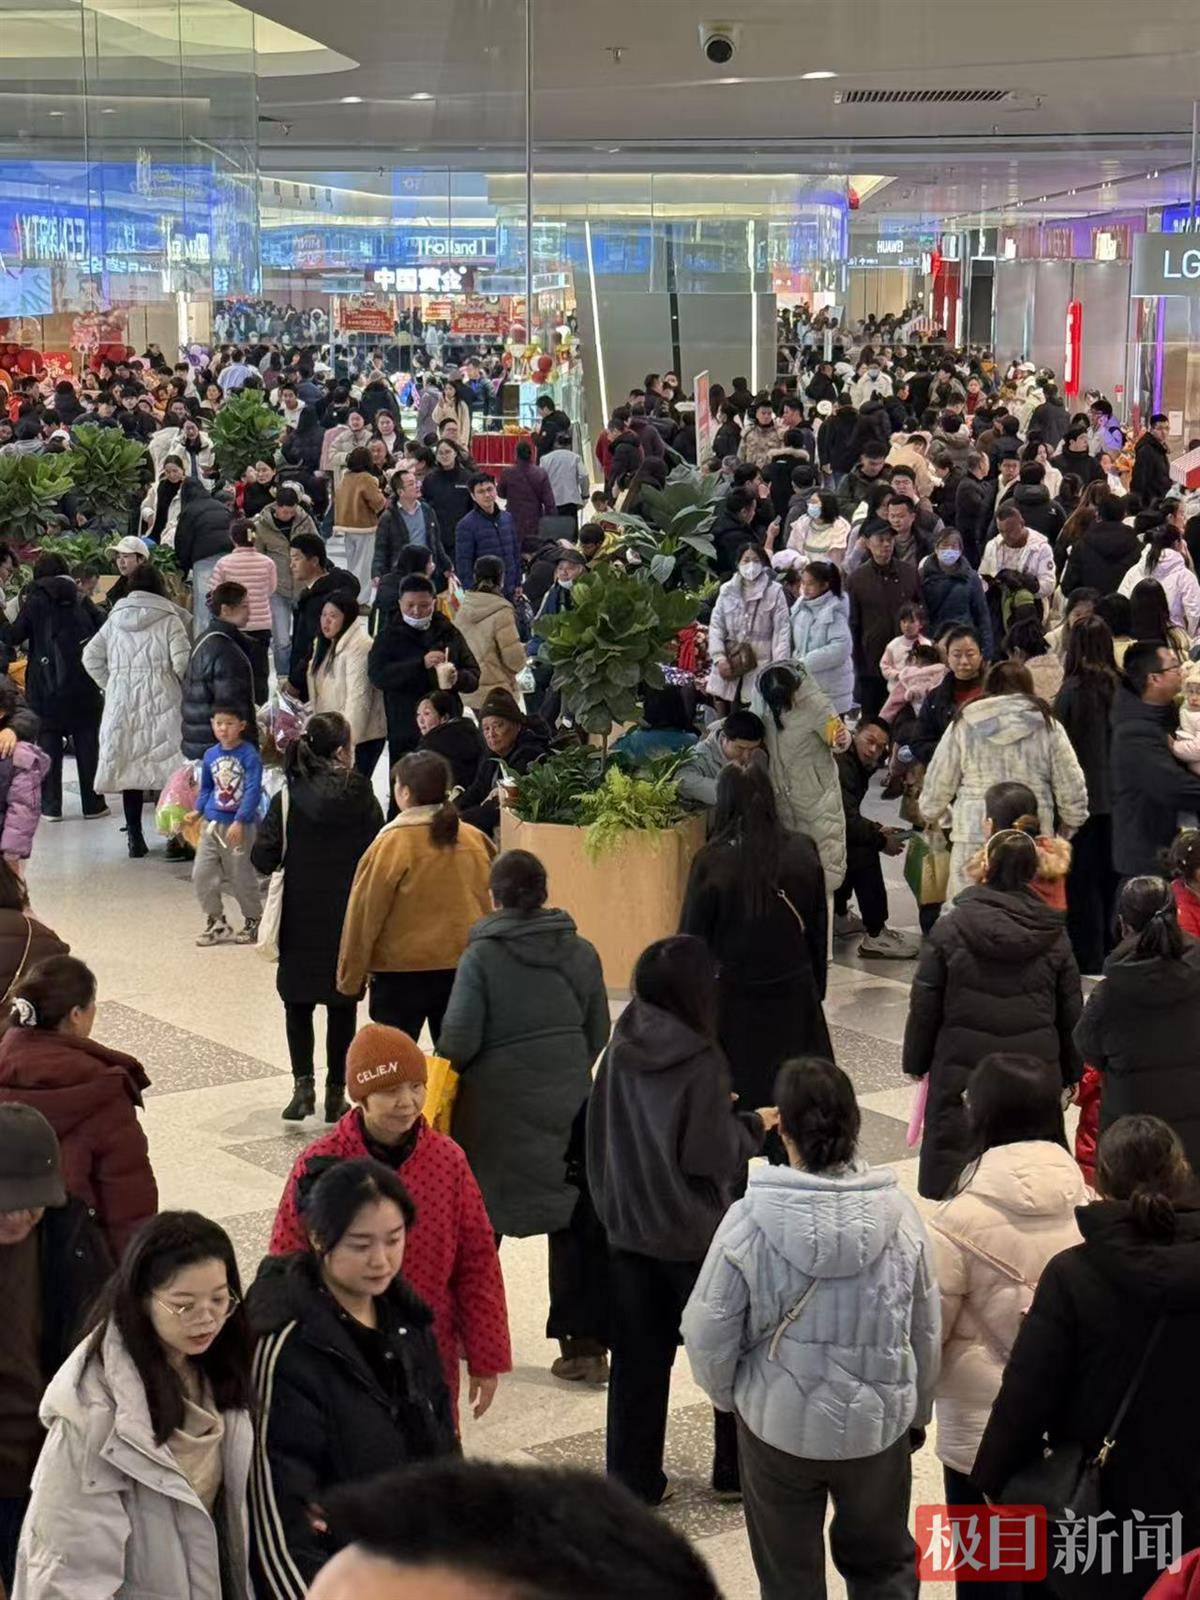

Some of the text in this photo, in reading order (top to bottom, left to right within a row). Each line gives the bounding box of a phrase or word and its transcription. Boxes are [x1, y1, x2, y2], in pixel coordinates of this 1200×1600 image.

[1164, 249, 1200, 278] LG
[374, 267, 462, 292] 中国黄金
[357, 1062, 398, 1084] CELIEN
